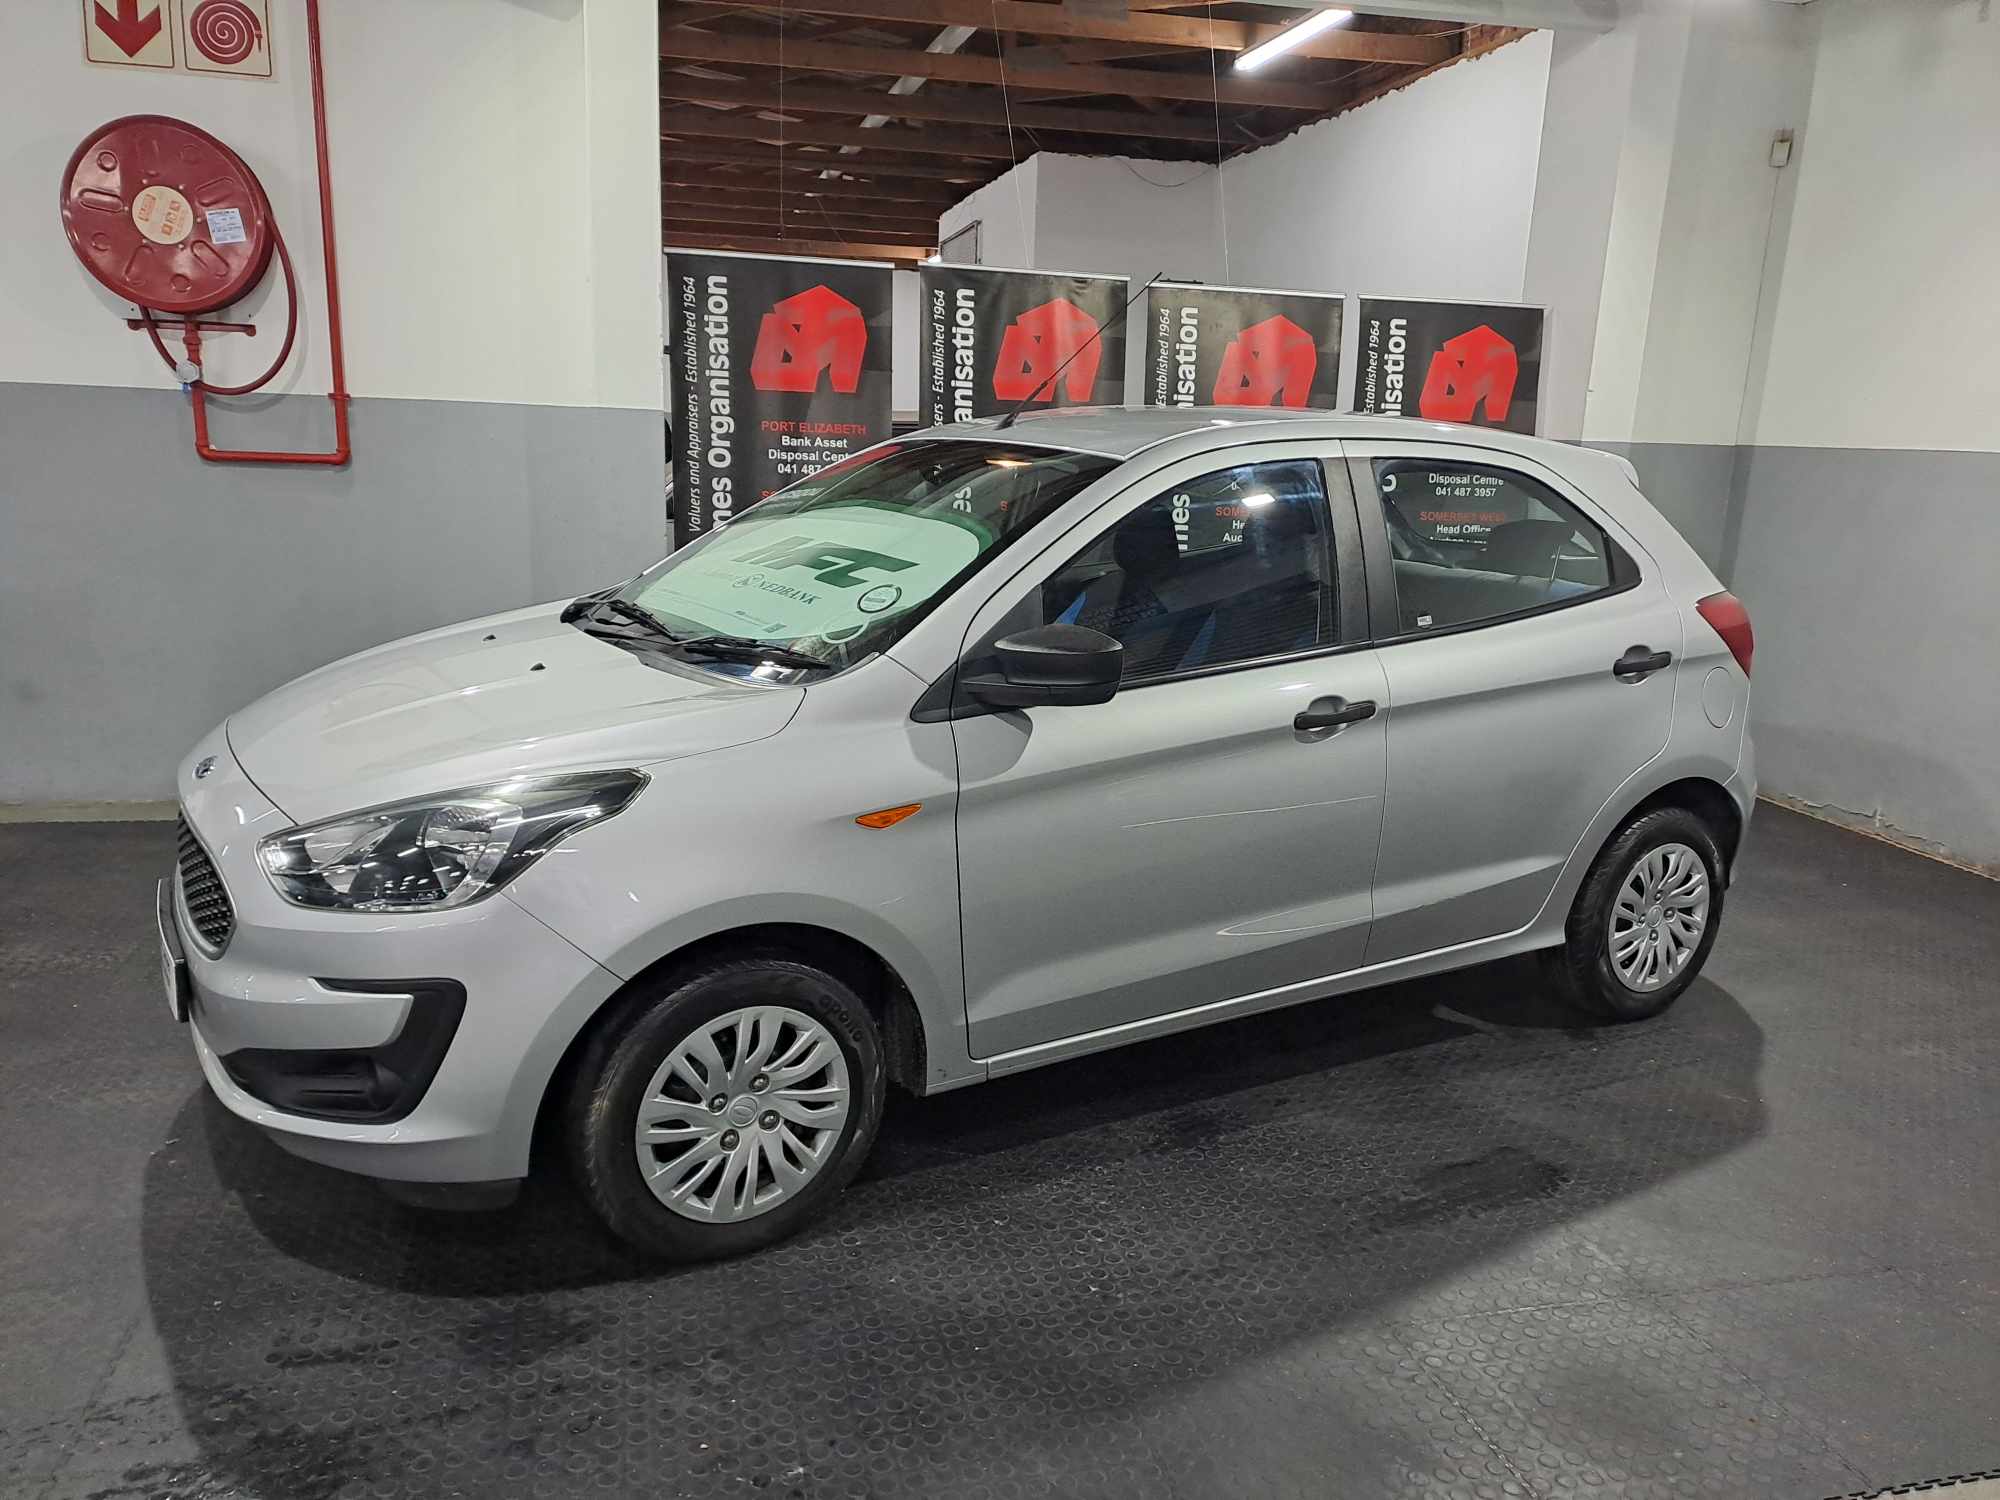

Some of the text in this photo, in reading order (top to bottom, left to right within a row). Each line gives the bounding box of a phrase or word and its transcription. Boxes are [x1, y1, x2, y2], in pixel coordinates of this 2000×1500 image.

[682, 275, 697, 308] 1964
[933, 288, 945, 320] 1964
[1369, 319, 1381, 348] 1964
[683, 310, 698, 383] Established
[931, 322, 945, 393] Established
[1156, 308, 1170, 408] Established 1964
[686, 393, 702, 458] Appraisers
[761, 421, 867, 435] PORT ELIZABETH
[781, 435, 848, 448] Bank Asset
[768, 449, 819, 462] Disposal
[687, 460, 701, 485] and
[777, 464, 822, 474] 041 487
[1428, 472, 1470, 486] Disposal
[1435, 486, 1497, 497] 041 487 3957
[687, 487, 702, 532] Valuers
[1222, 532, 1243, 542] Auc
[1436, 524, 1461, 534] Head
[759, 580, 823, 605] NEDBANK
